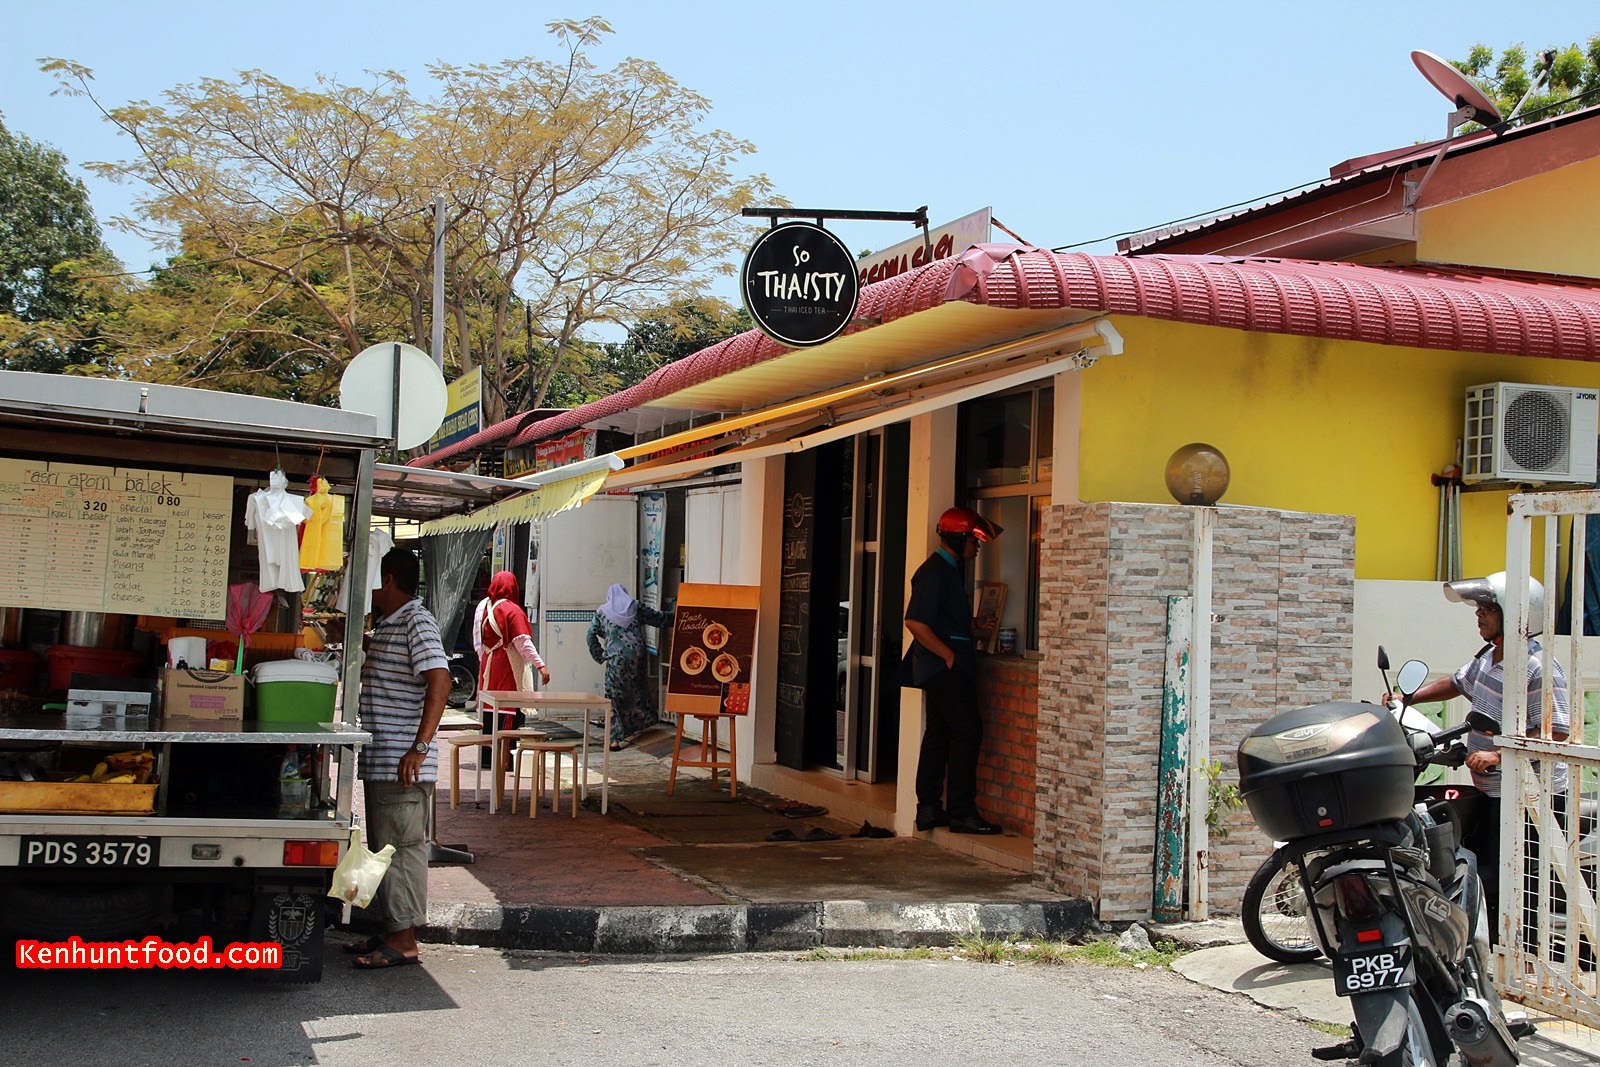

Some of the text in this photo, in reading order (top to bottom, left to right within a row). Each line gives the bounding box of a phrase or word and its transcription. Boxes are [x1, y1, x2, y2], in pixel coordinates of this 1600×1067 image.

[757, 270, 846, 302] THA!STY
[784, 305, 826, 315] THAI ICED TEA
[30, 471, 60, 485] asri
[125, 472, 174, 496] balek
[178, 520, 196, 528] 1.00
[206, 522, 226, 531] 4.00
[136, 526, 165, 537] Jagung
[178, 530, 194, 540] 1.00
[205, 532, 226, 542] 4.00
[174, 542, 196, 552] 1.20
[203, 545, 226, 555] 4.80
[113, 560, 144, 572] Pisang
[173, 565, 193, 574] 1.20
[172, 555, 194, 564] 1.00
[202, 558, 224, 566] 4.00
[172, 576, 192, 584] 1.40
[202, 578, 223, 587] 5.60
[114, 582, 142, 591] coklat
[201, 590, 221, 598] 6.80
[112, 592, 220, 608] cheese 2.20 8.80
[681, 612, 702, 621] Boat
[678, 618, 708, 631] Noodle
[1294, 728, 1314, 738] GIVI
[27, 842, 151, 865] PDS 3579
[1352, 954, 1395, 974] PKB
[1346, 967, 1404, 990] 6977
